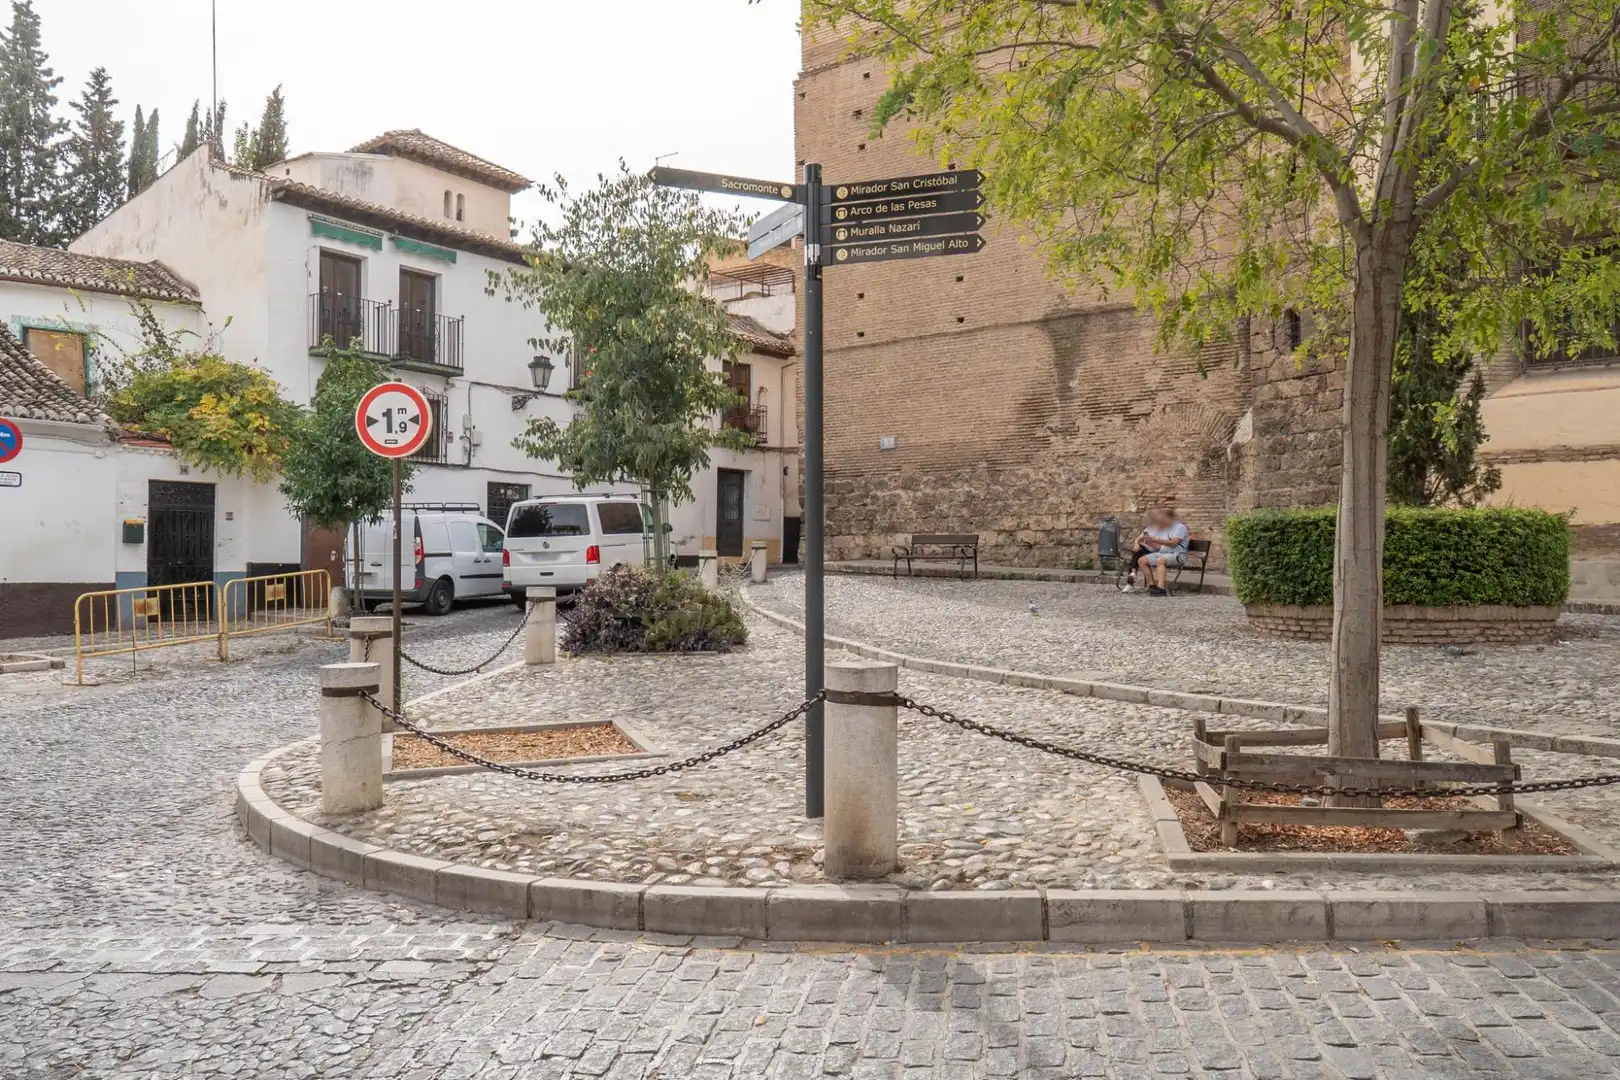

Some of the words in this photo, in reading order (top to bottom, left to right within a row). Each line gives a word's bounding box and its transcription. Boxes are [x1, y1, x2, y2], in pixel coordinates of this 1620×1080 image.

[721, 179, 779, 194] Sacromonte
[851, 184, 888, 195] Mirador
[891, 181, 909, 191] San
[913, 175, 958, 189] Cristóbal
[850, 206, 873, 216] Arco
[875, 204, 888, 213] de
[891, 202, 904, 212] las
[908, 200, 937, 210] Pesas
[850, 225, 886, 236] Muralla
[889, 221, 920, 233] Nazarí
[850, 245, 887, 257] Mirador
[890, 244, 909, 254] San
[913, 240, 945, 252] Miguel
[948, 239, 969, 249] Alto
